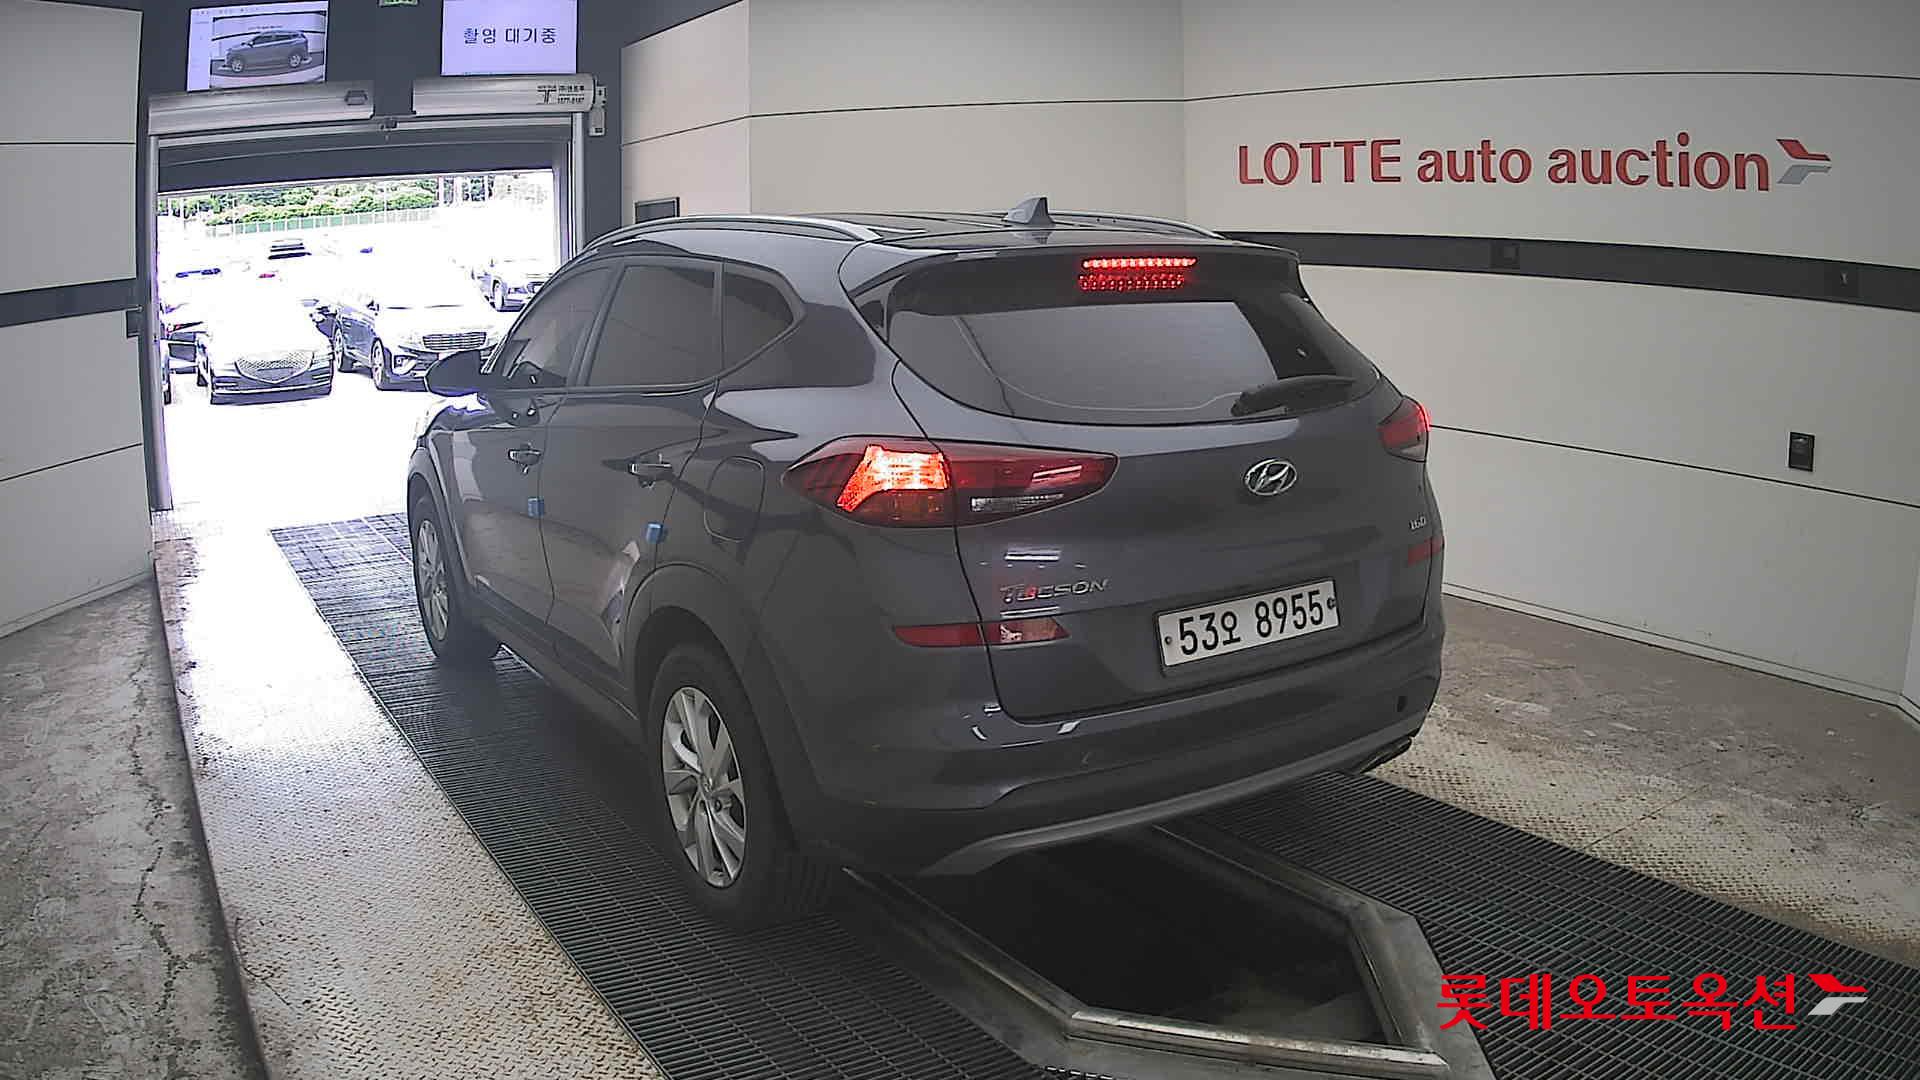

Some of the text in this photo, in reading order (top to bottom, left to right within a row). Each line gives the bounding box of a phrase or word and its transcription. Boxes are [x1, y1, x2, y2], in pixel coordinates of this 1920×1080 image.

[464, 28, 556, 44] 촬영 대기중
[1239, 131, 1770, 191] LOTTE auto auction
[1178, 589, 1324, 656] 53오 8955
